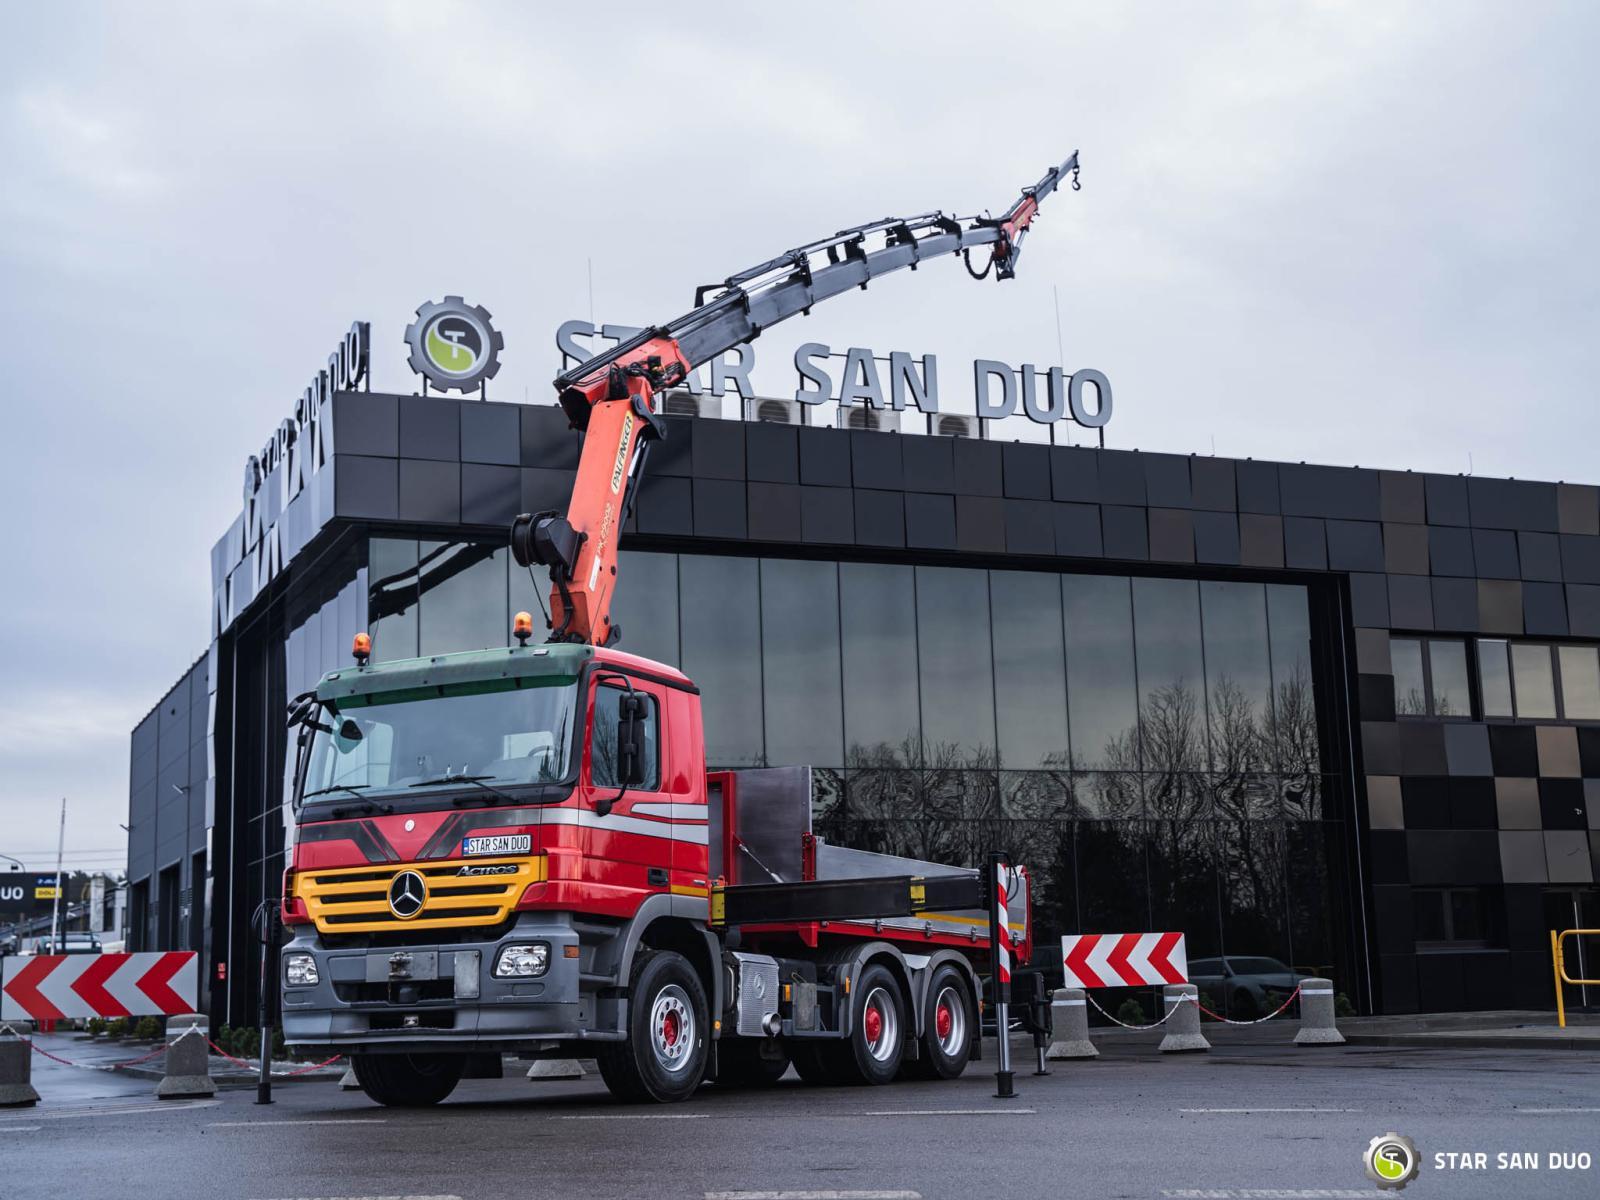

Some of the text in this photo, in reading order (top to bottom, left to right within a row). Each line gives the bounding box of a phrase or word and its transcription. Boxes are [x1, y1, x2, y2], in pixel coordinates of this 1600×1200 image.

[556, 319, 1113, 428] STR SAN DUO
[612, 415, 633, 490] PALFINGER
[470, 836, 528, 852] STAR SAN DUO
[0, 886, 24, 900] UO
